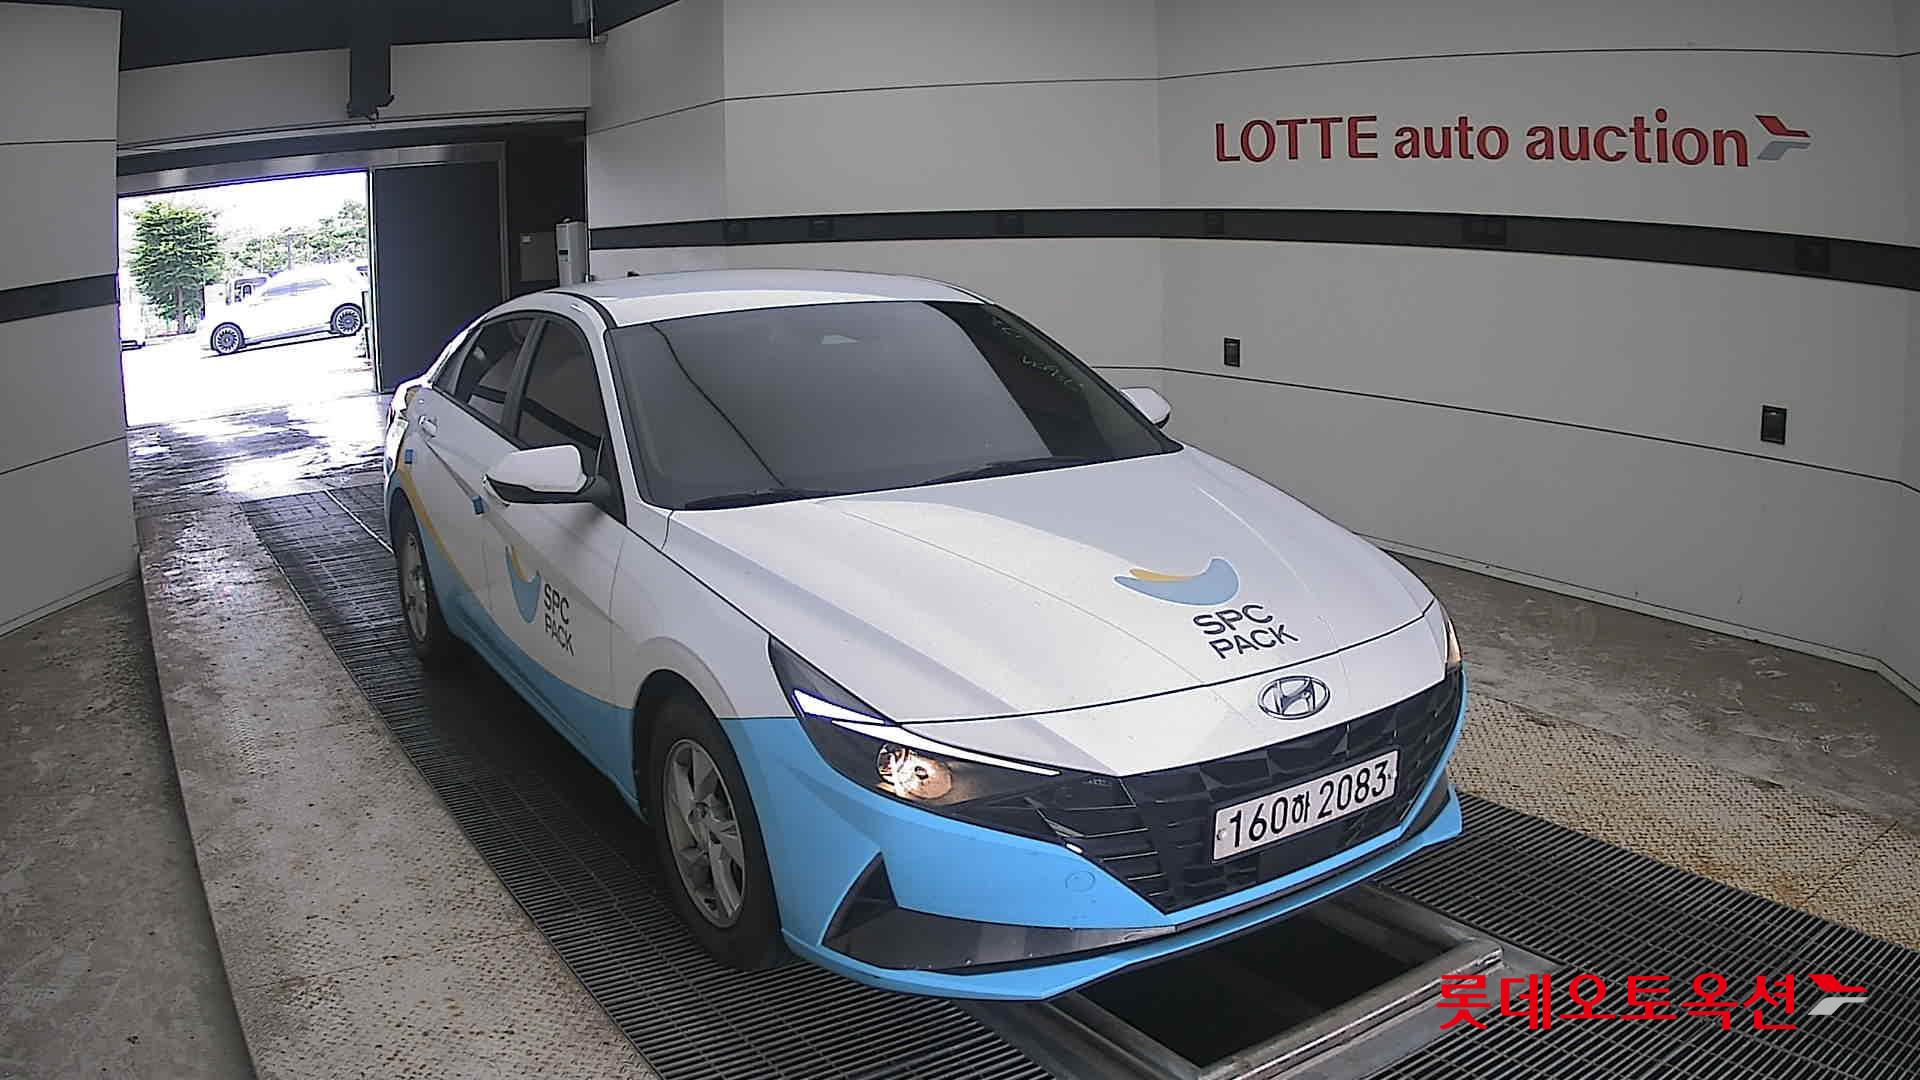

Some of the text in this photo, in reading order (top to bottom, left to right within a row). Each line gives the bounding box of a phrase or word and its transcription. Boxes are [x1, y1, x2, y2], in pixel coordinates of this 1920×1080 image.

[1214, 107, 1750, 168] LOTTE auto auction
[543, 583, 570, 625] SPC
[1193, 603, 1274, 636] SPC
[545, 613, 575, 657] PACK
[1208, 624, 1299, 660] PACK
[1229, 759, 1389, 848] 160하 2083
